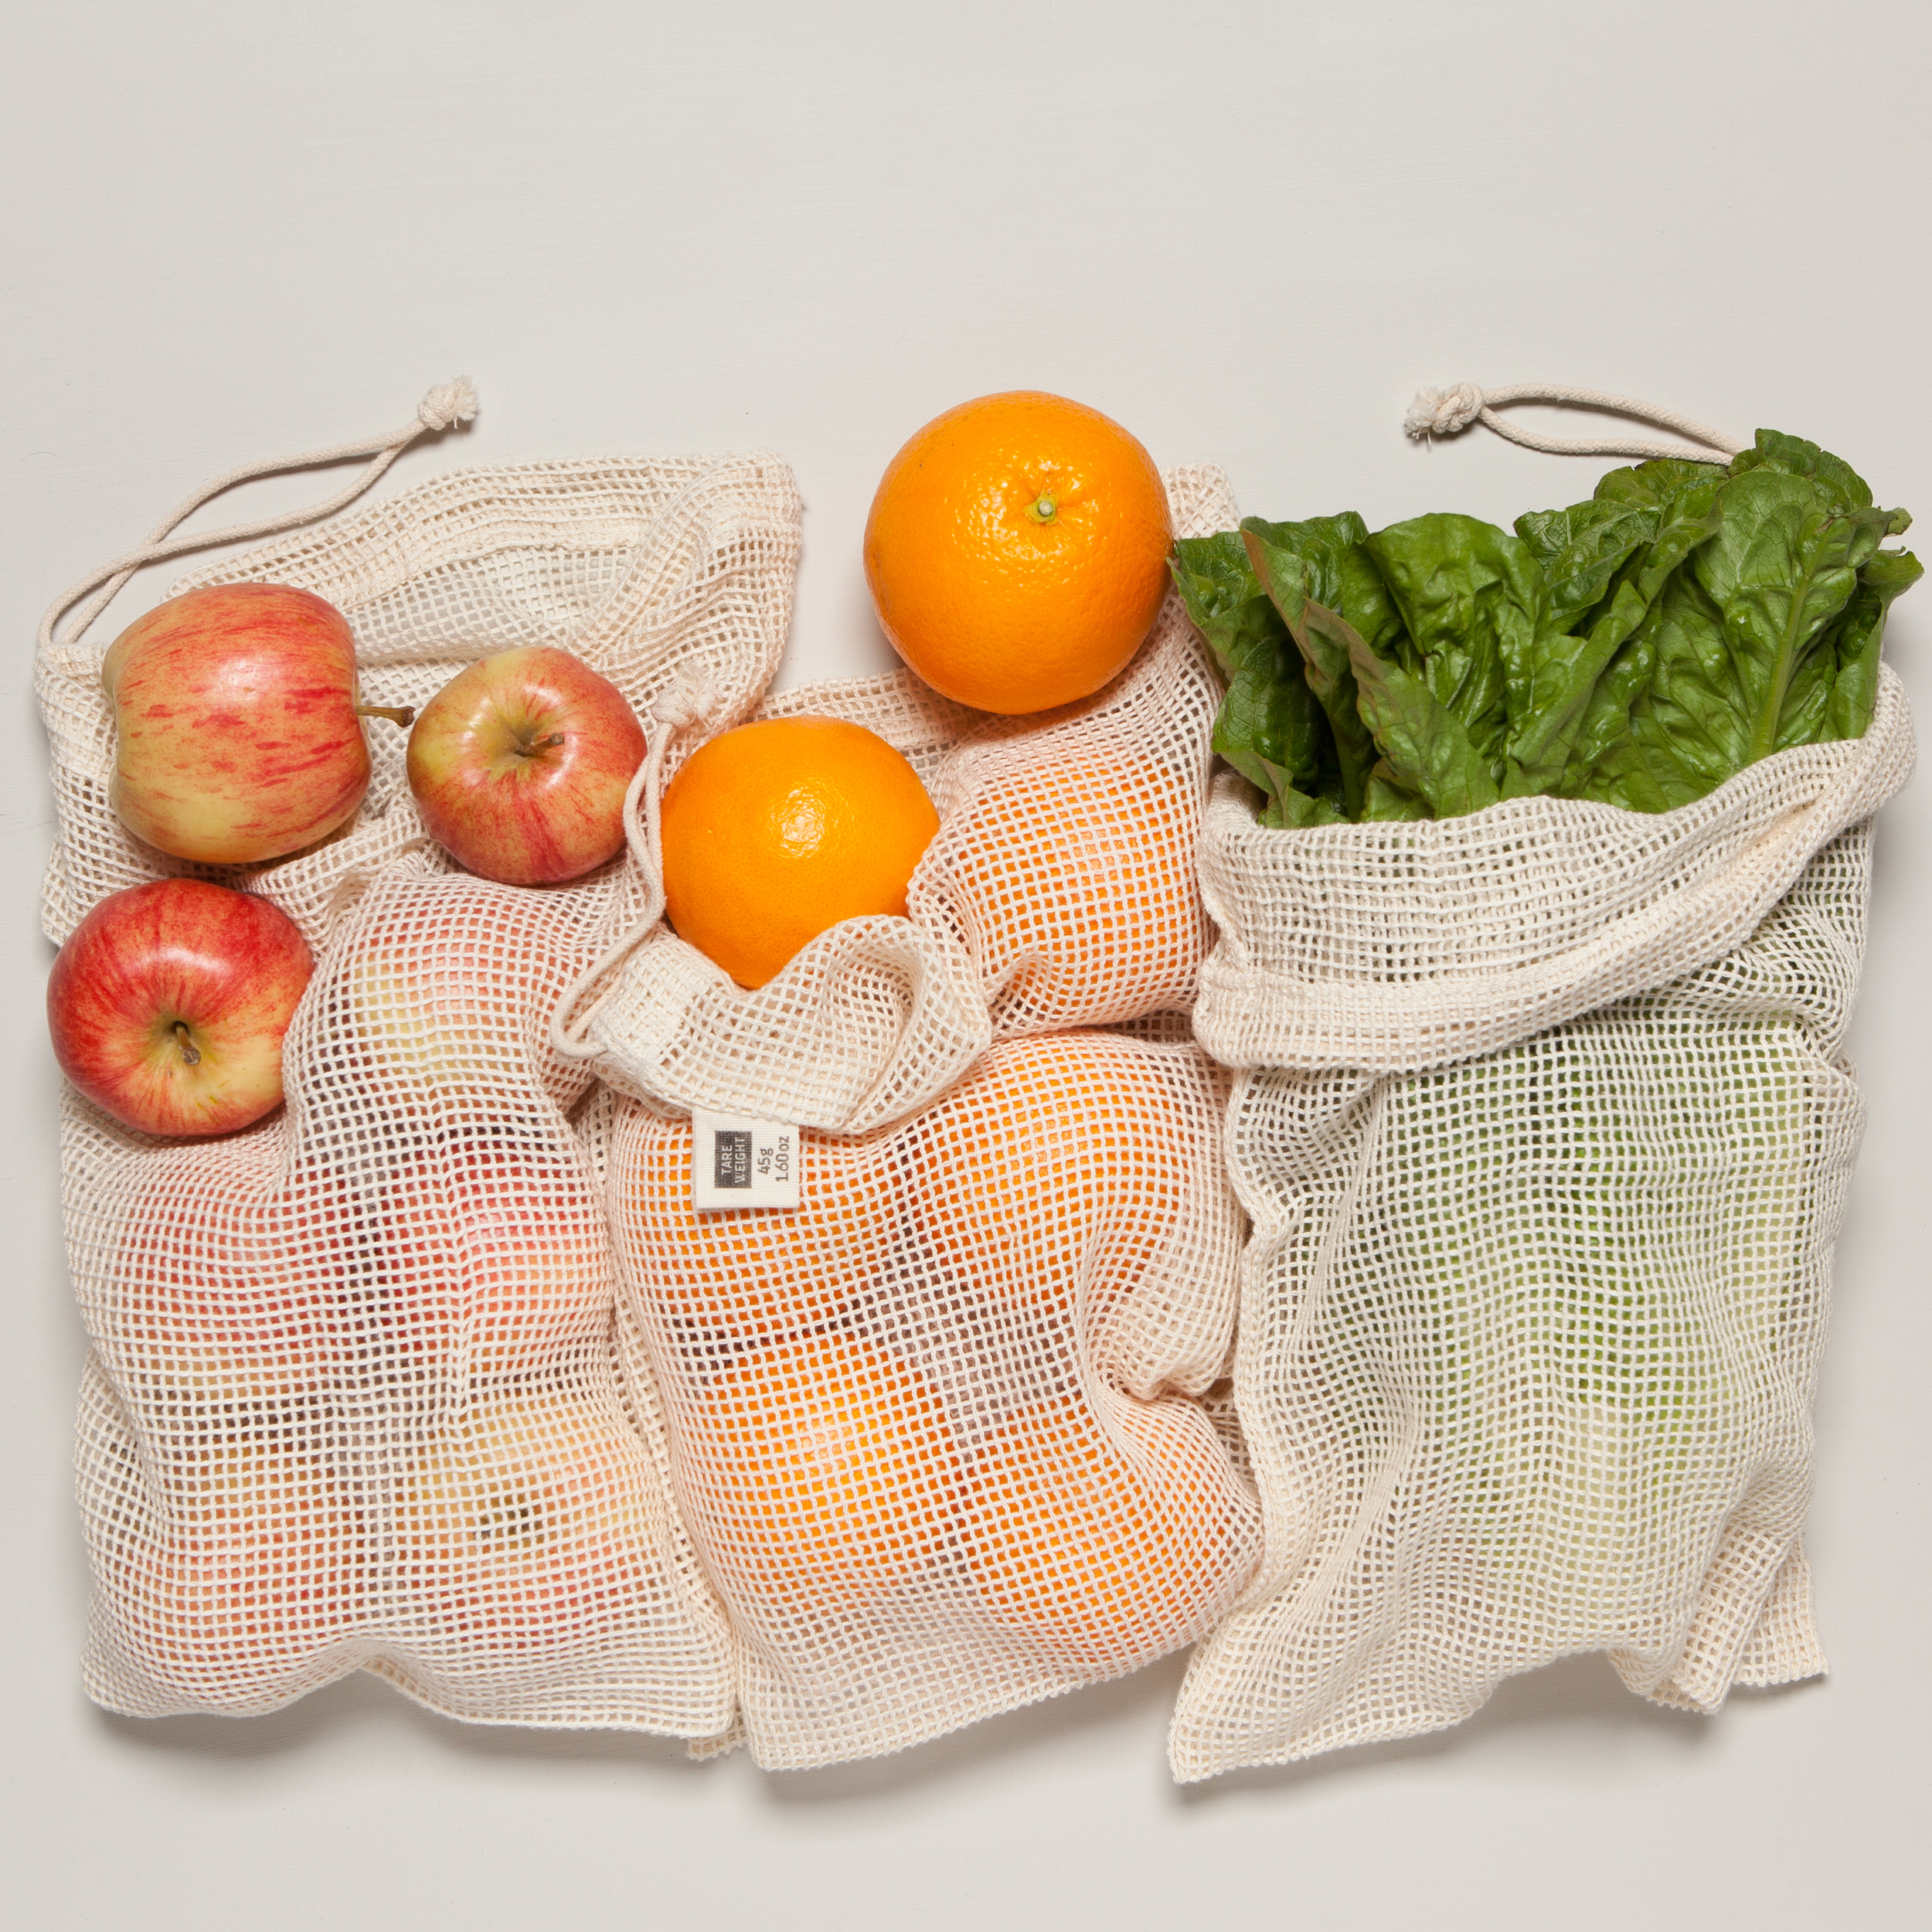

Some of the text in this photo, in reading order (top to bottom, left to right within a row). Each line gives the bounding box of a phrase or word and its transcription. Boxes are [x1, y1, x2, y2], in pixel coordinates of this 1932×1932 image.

[778, 1136, 790, 1151] oz
[721, 1145, 733, 1175] TARE
[734, 1137, 746, 1183] WEIGHT
[757, 1148, 774, 1175] 45g
